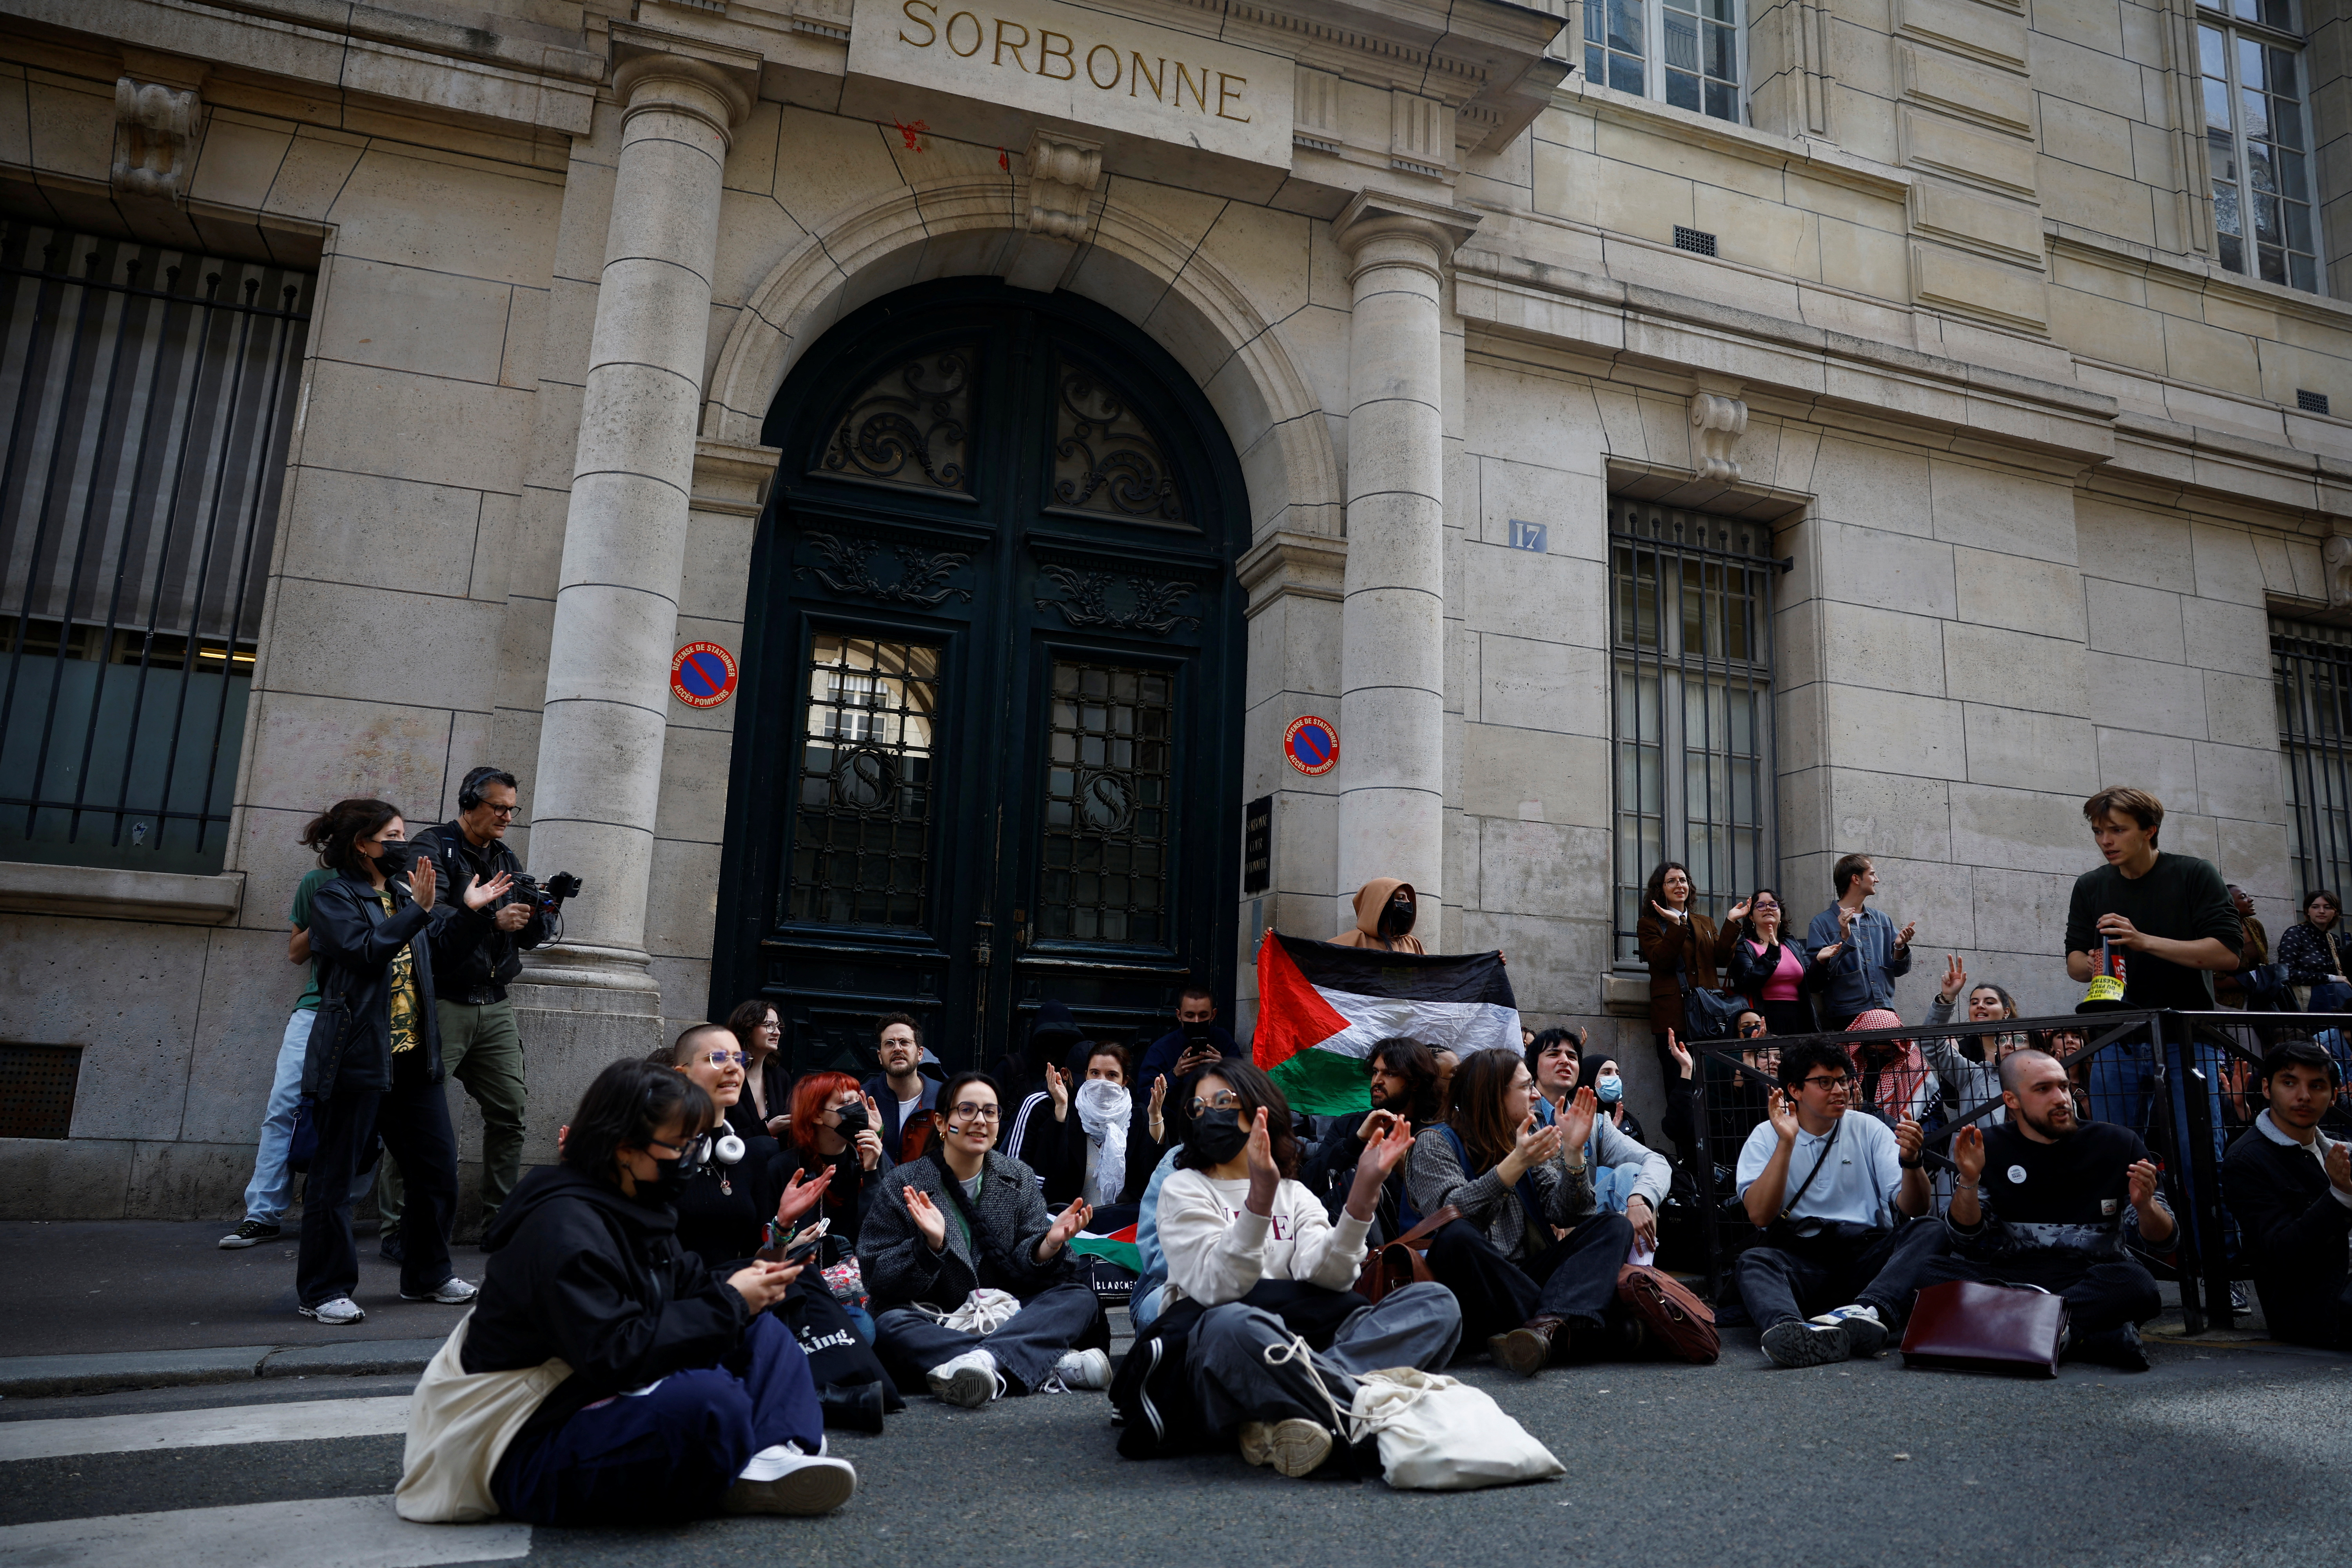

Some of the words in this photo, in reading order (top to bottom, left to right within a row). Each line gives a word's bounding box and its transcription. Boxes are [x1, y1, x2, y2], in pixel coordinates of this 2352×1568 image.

[899, 0, 1250, 123] SORBONNE
[1516, 523, 1540, 549] 17
[672, 646, 695, 671] DÉFENSE
[706, 645, 735, 677] STATIONNER
[674, 684, 693, 702] ACCÈS
[694, 689, 729, 705] POMPIERS
[1286, 719, 1304, 742] DÉFENSE
[1313, 718, 1338, 748] STATIONNER
[1289, 755, 1305, 771] ACCÈS
[1306, 759, 1334, 773] POMPIERS
[1246, 813, 1268, 833] SORBONNE
[1250, 838, 1262, 852] COUR
[1245, 857, 1267, 875] D'HONNEUR
